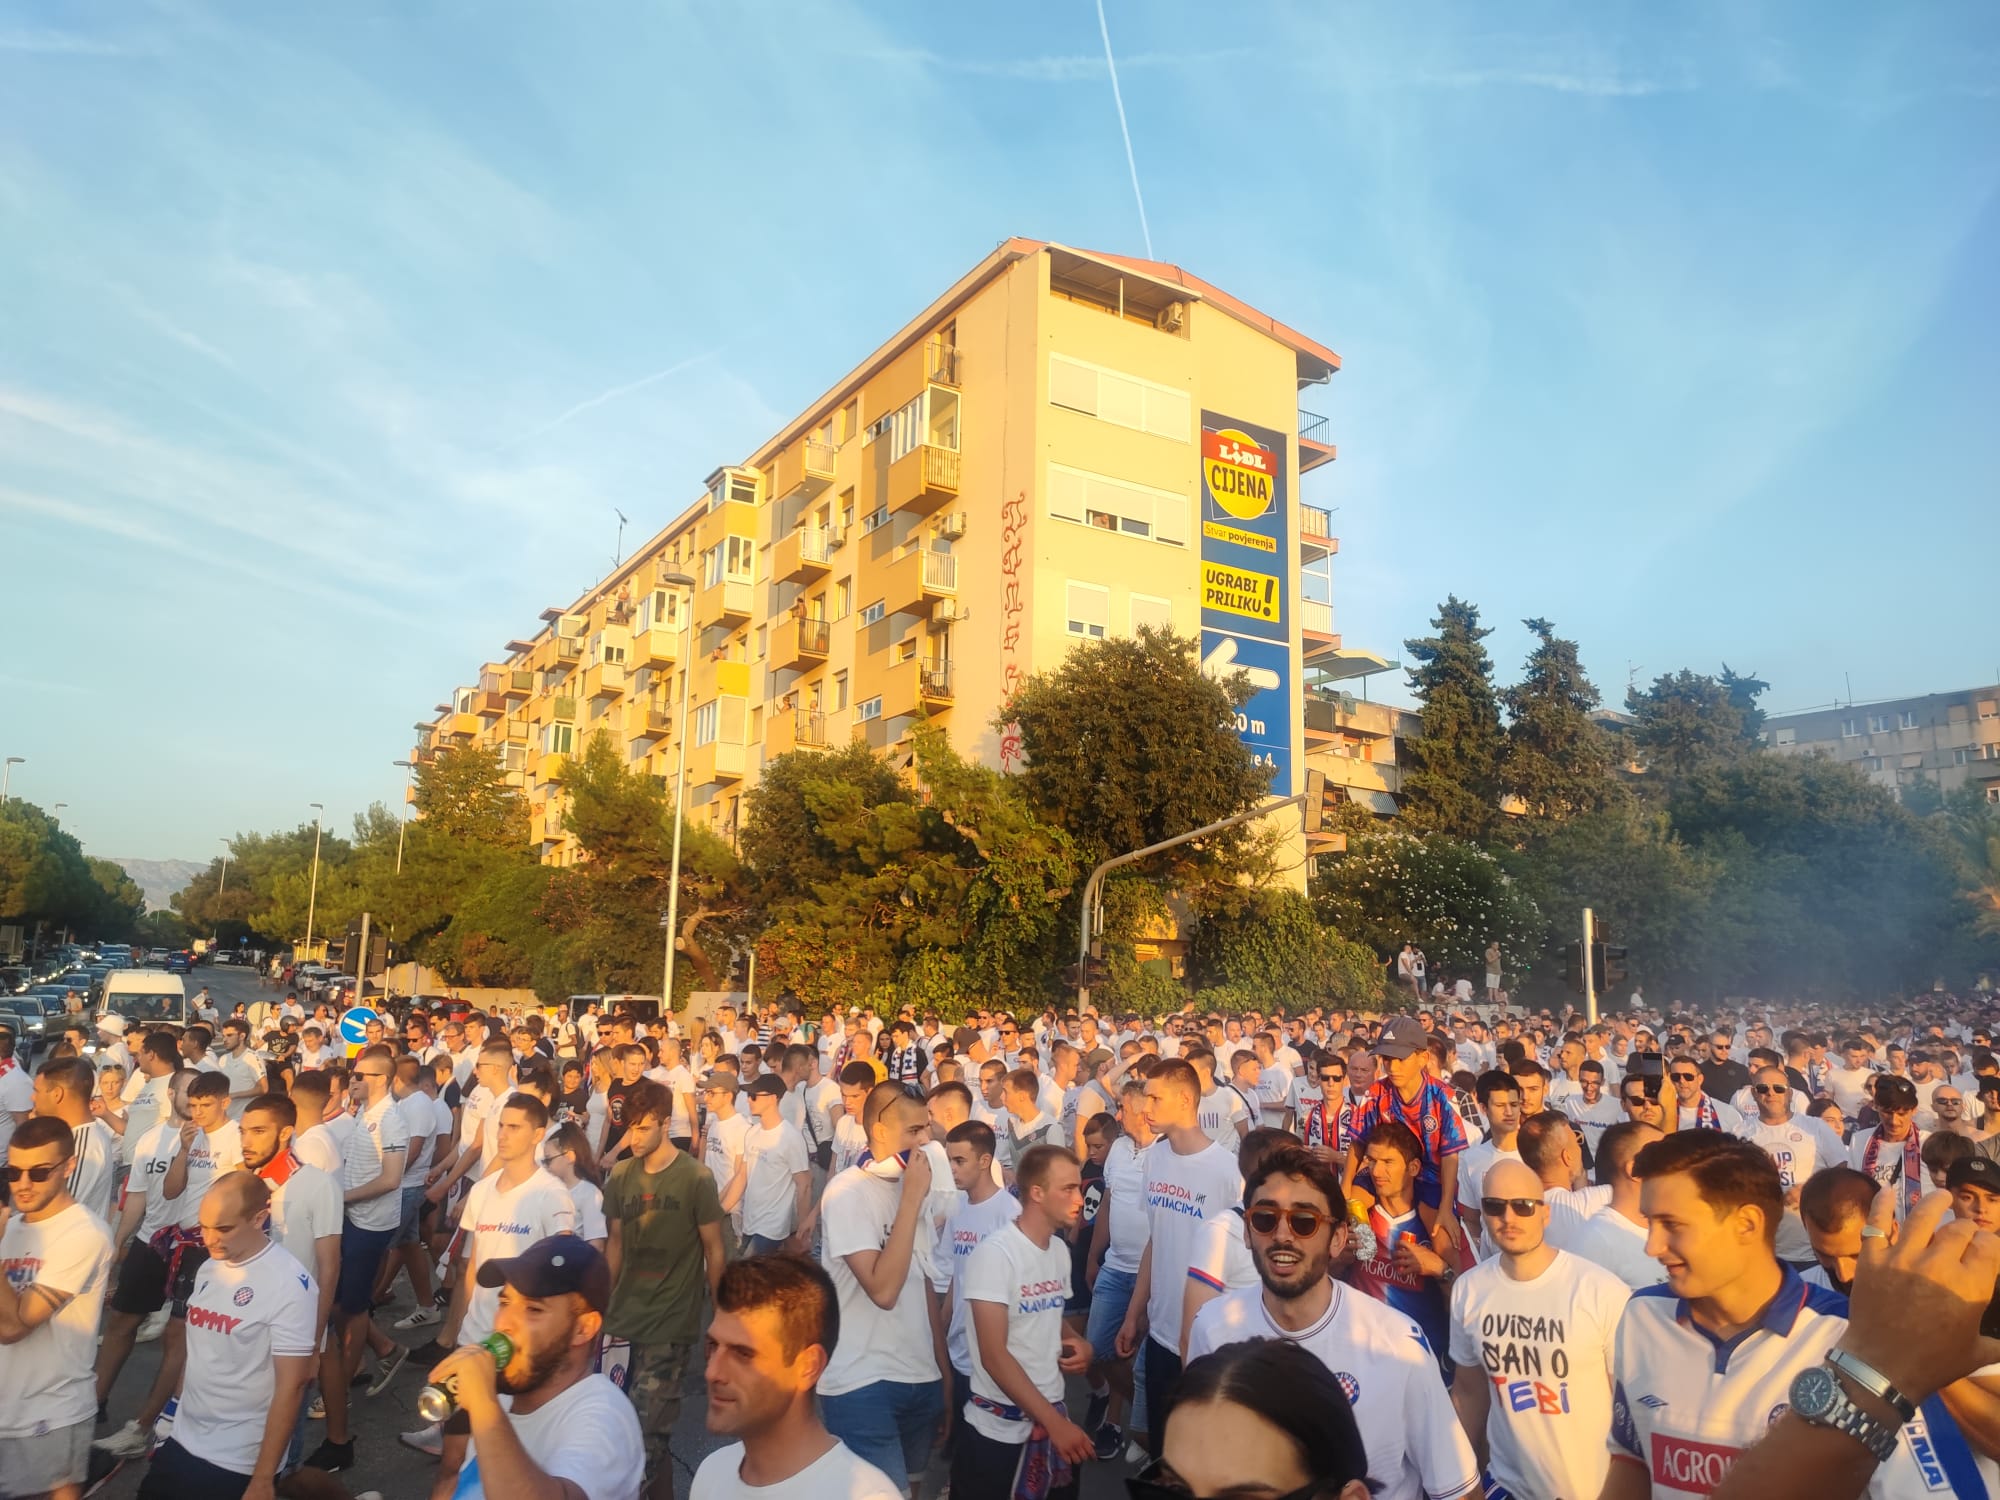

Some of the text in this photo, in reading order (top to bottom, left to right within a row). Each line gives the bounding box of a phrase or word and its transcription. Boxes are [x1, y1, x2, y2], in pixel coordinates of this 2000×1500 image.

[1211, 464, 1268, 501] CIJENA
[1205, 524, 1275, 551] Stvar povjerenja
[1206, 568, 1259, 594] UGRABI
[1206, 588, 1262, 613] PRILIKU
[1251, 719, 1266, 735] m
[1148, 1181, 1191, 1202] SLOBODA
[1482, 1340, 1569, 1379] SAN O
